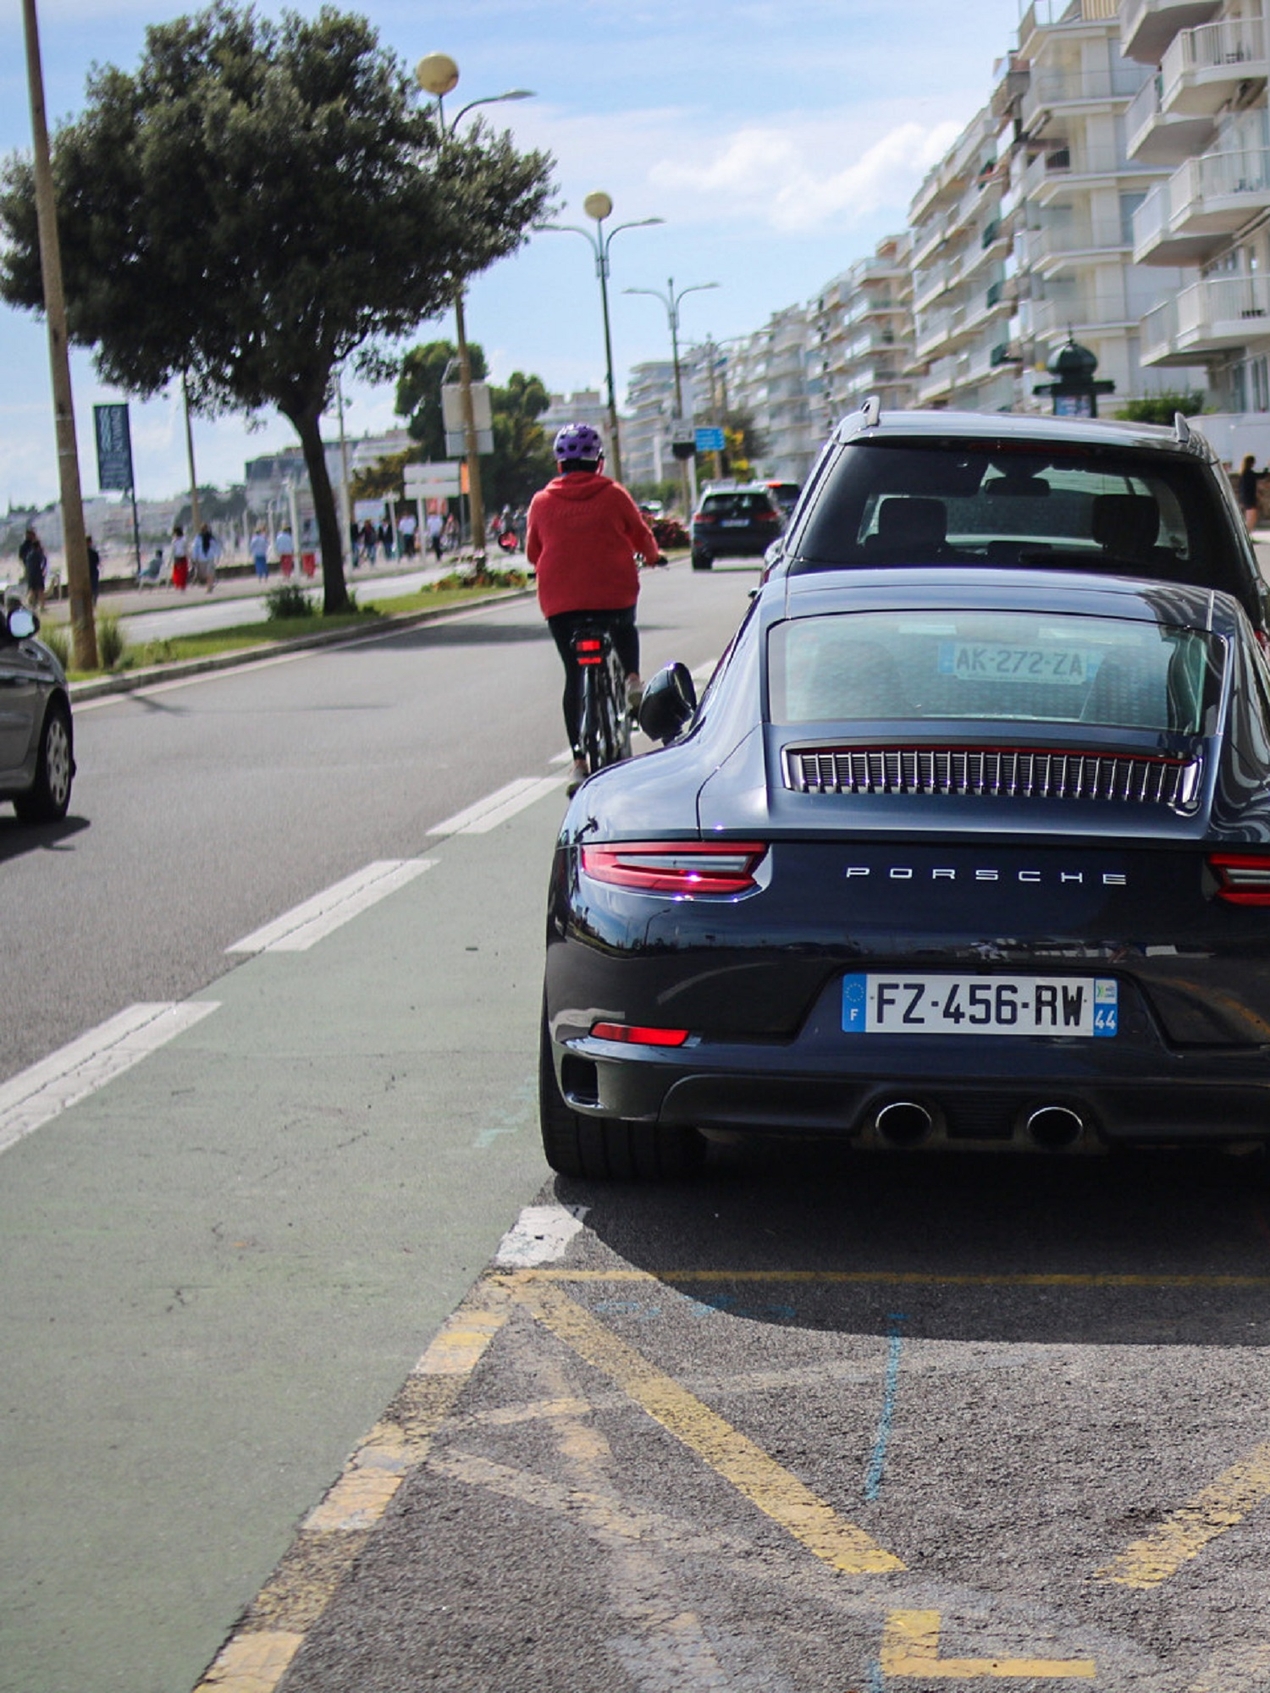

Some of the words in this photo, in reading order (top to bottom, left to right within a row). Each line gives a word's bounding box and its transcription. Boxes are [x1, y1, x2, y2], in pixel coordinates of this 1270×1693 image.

[956, 648, 1083, 676] AK-272-ZA
[846, 867, 1127, 885] PORSCHE
[850, 1008, 859, 1021] F
[876, 983, 1084, 1027] FZ-456-RW
[1095, 1010, 1116, 1029] 44
